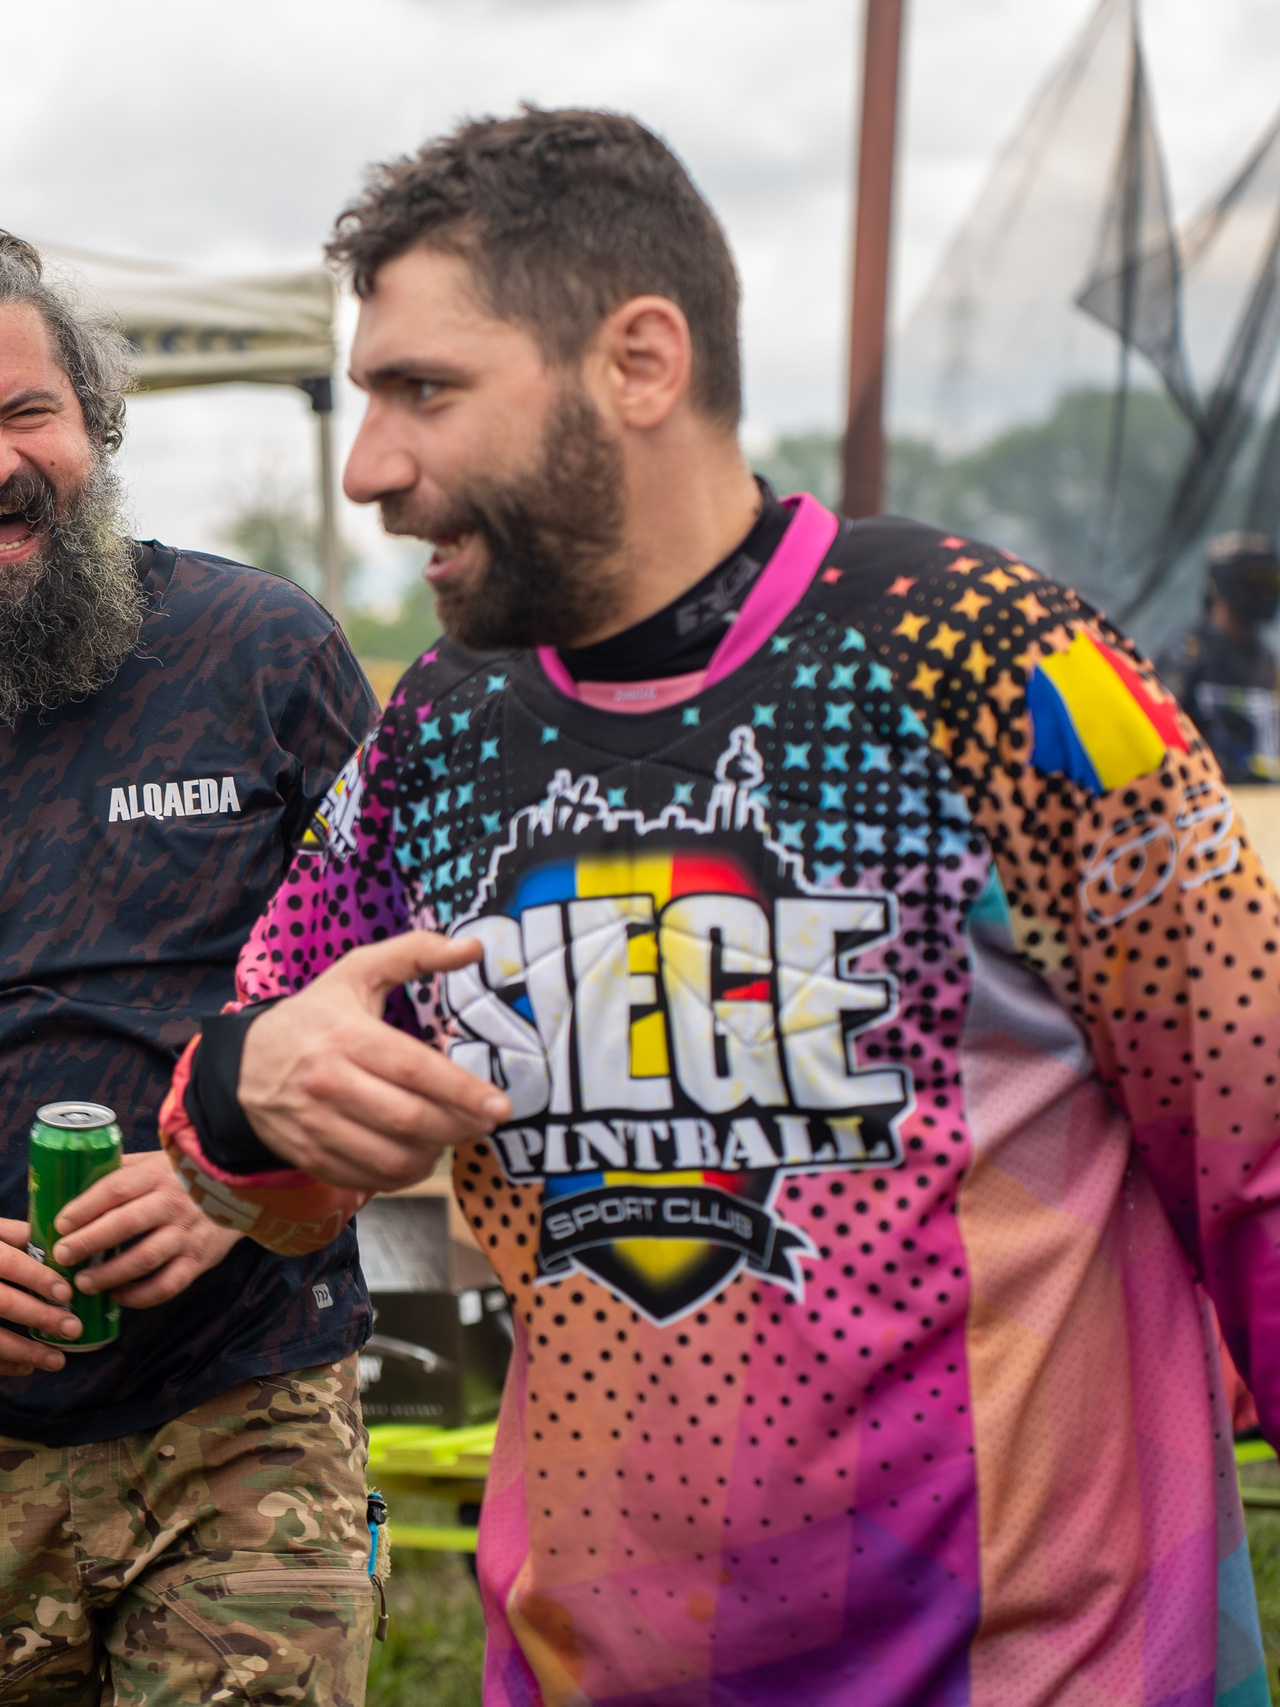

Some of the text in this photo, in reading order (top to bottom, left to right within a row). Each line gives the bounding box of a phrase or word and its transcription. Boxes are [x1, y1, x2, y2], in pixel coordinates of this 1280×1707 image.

[108, 776, 242, 823] ALQAEDA
[444, 893, 910, 1120] SIEGE
[494, 1114, 893, 1172] PINTBALL
[545, 1196, 754, 1240] SPORT CLUB
